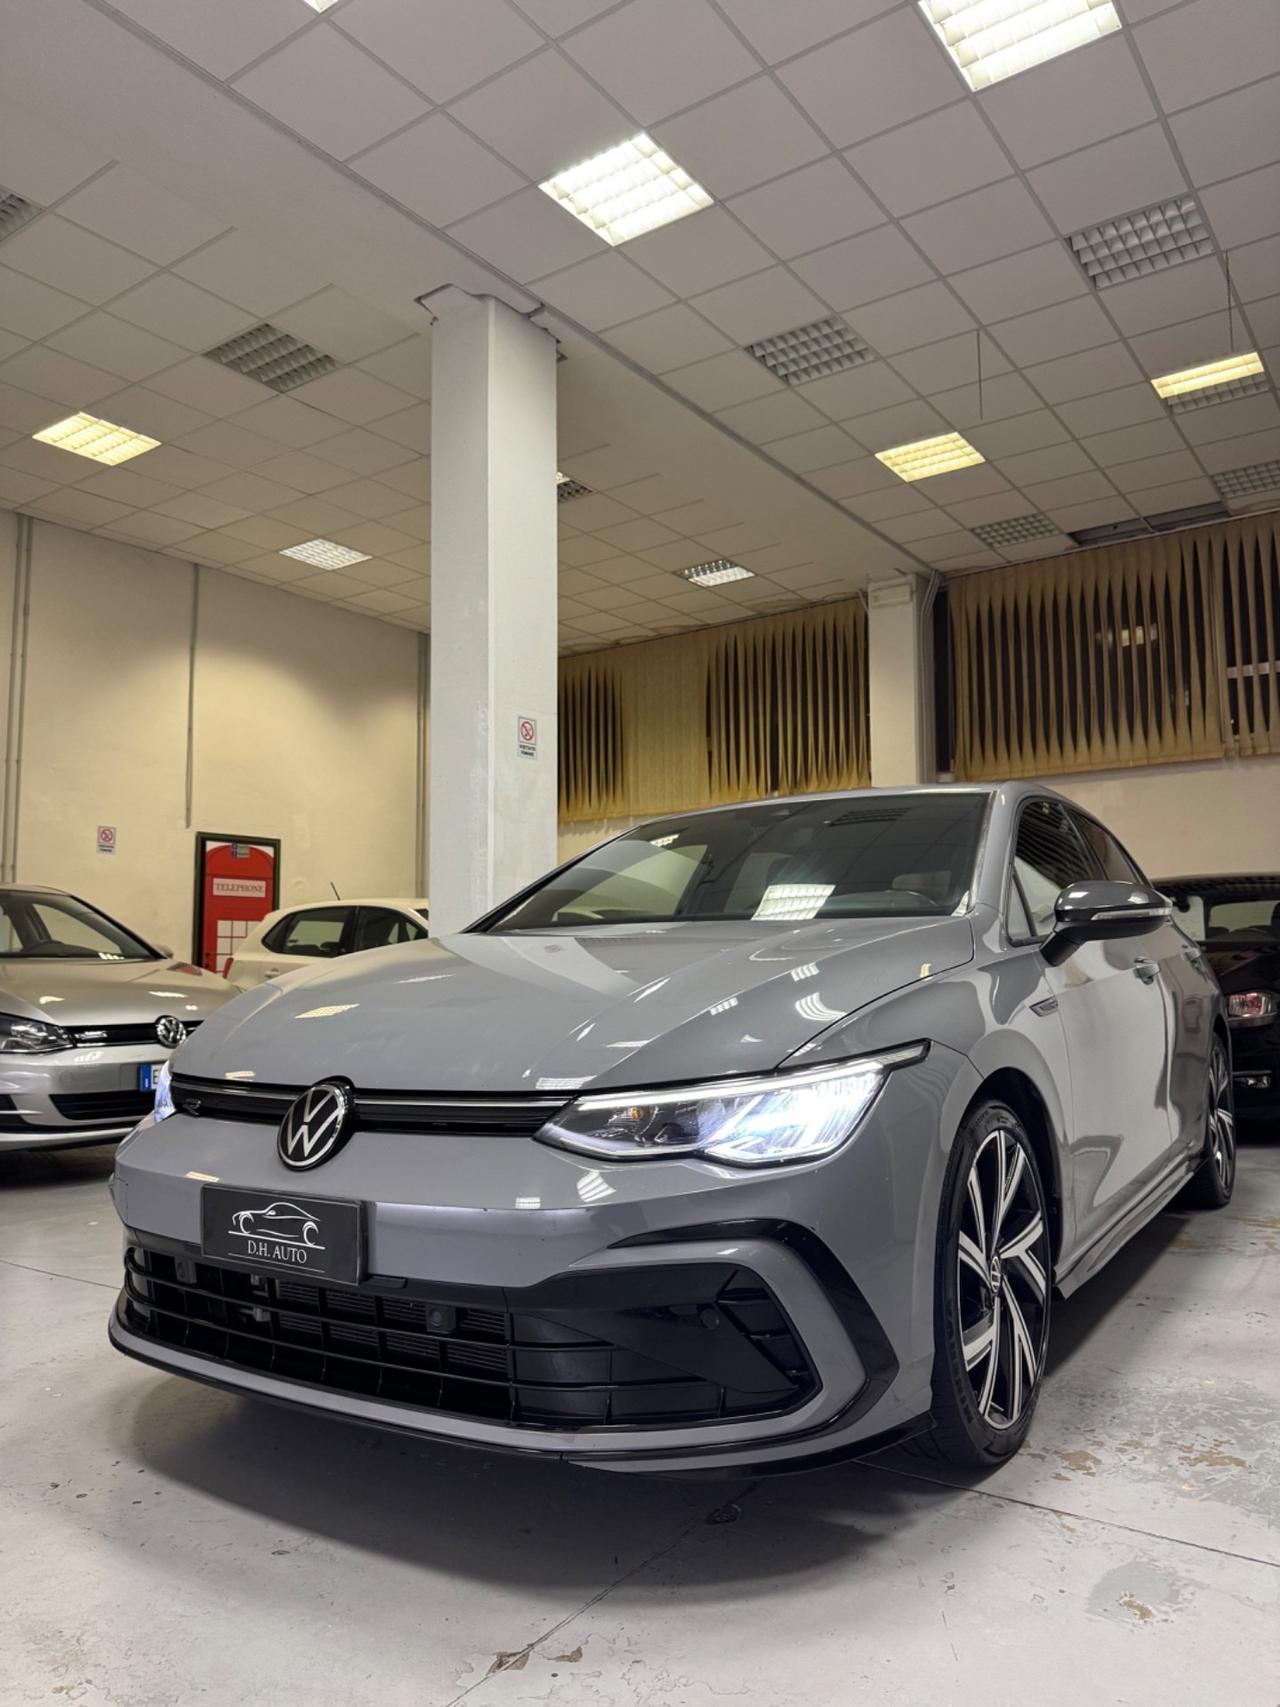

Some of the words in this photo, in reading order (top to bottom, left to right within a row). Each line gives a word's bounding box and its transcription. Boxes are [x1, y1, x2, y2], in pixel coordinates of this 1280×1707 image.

[215, 882, 264, 894] TELEPHONE
[247, 1240, 271, 1258] D.H.
[272, 1245, 308, 1264] AUTO
